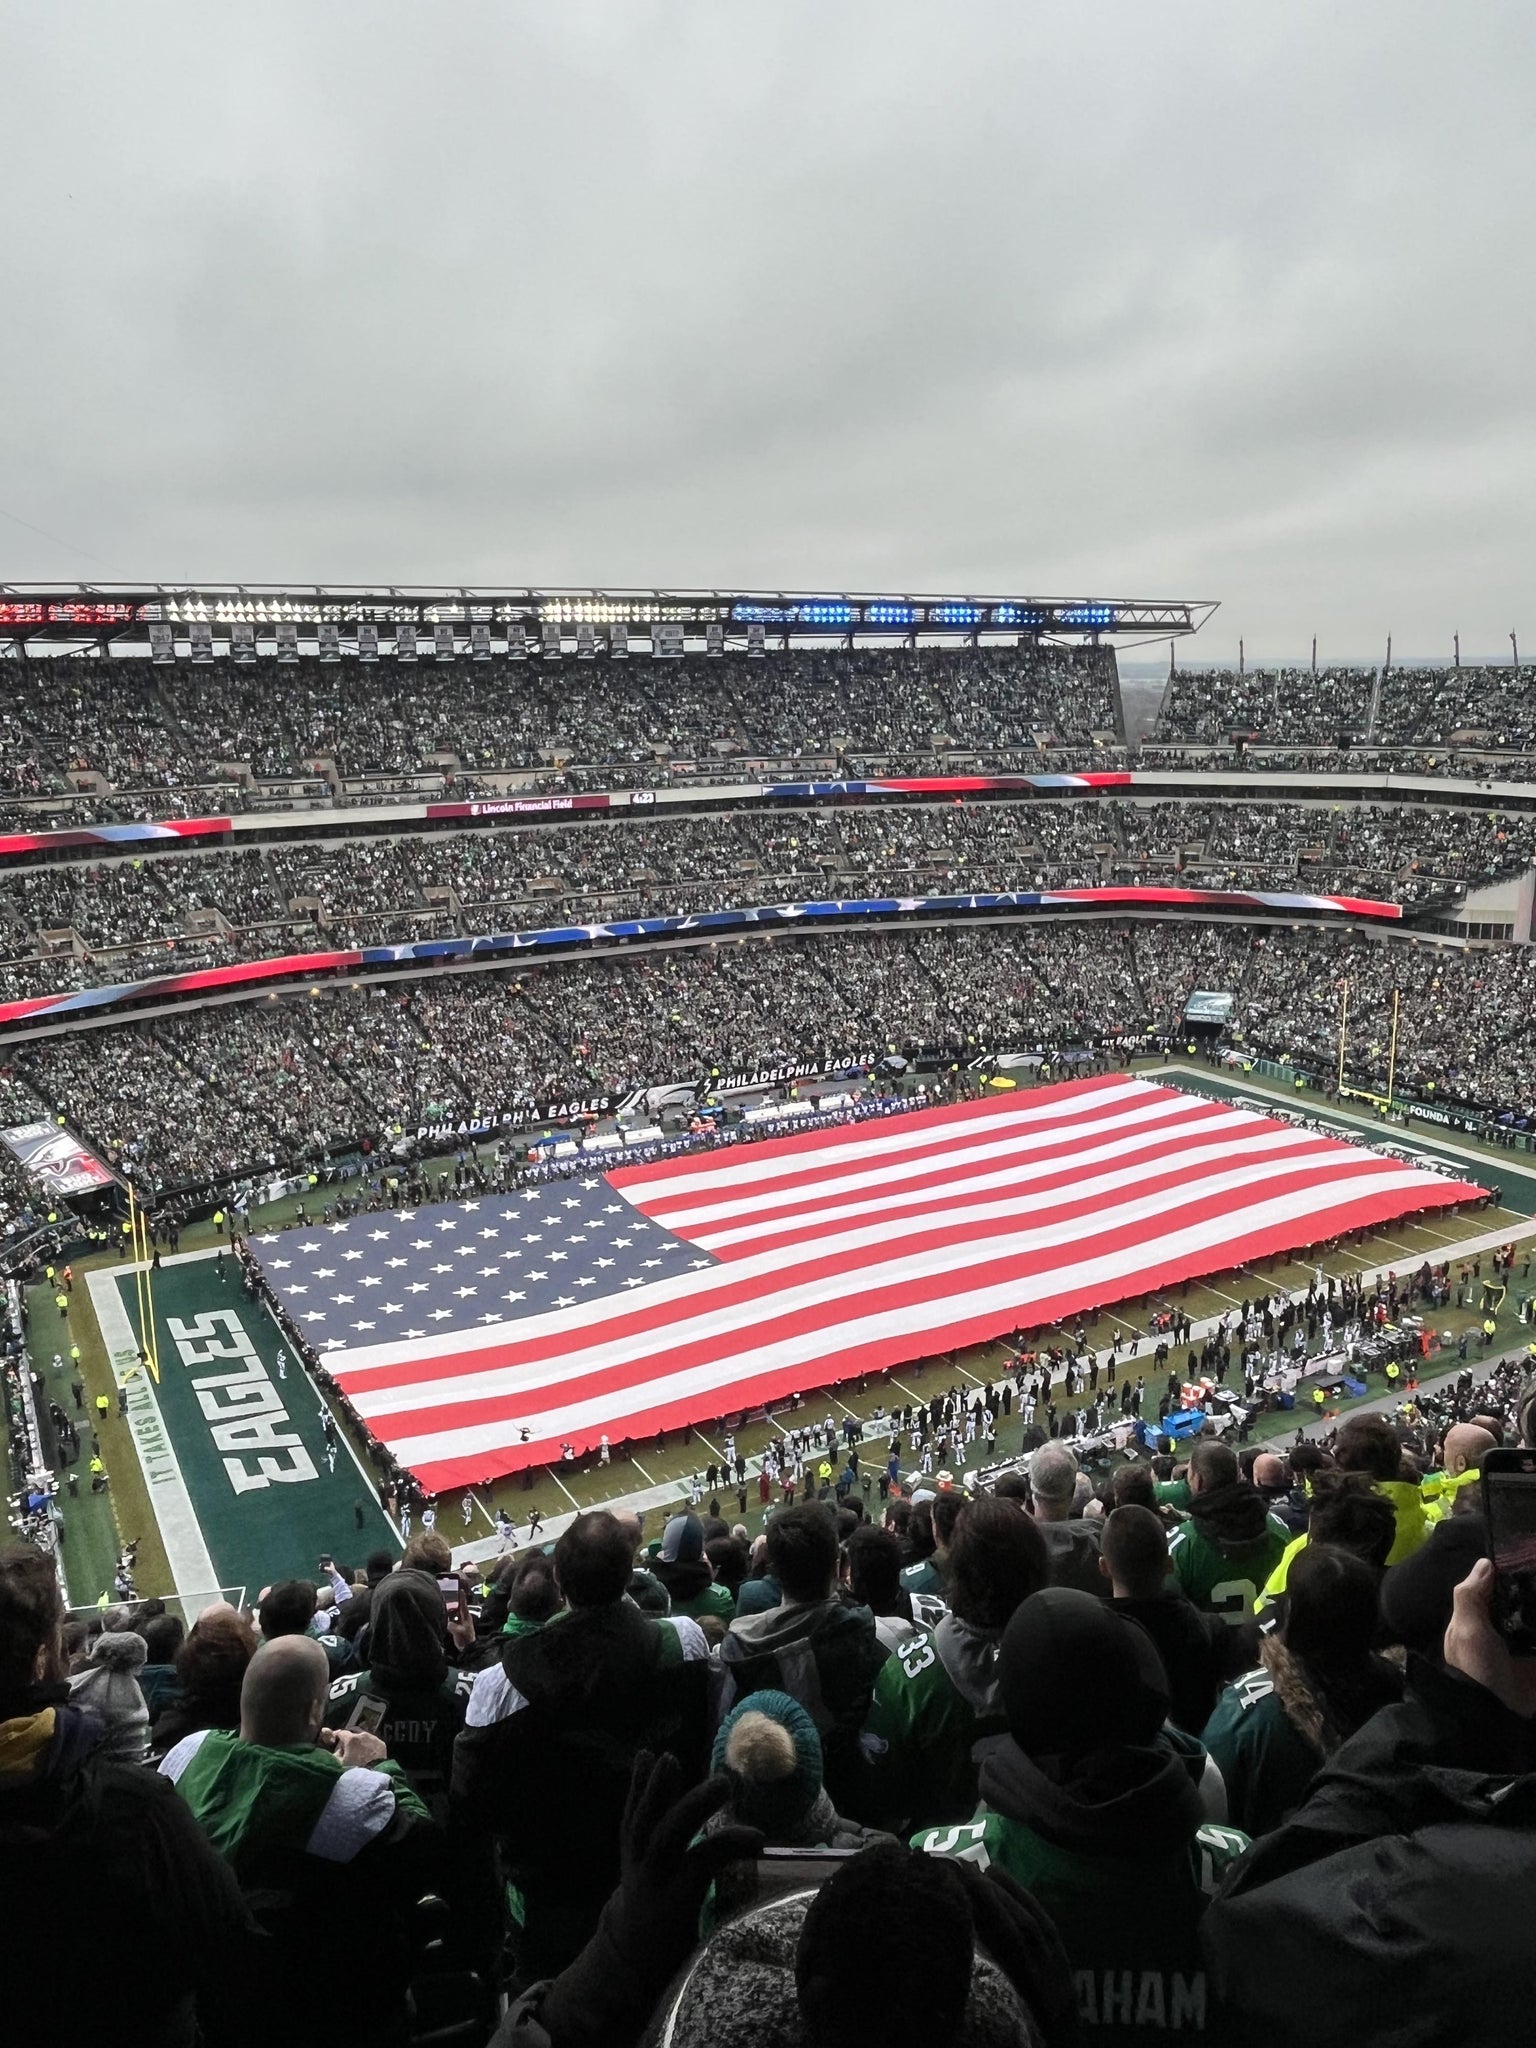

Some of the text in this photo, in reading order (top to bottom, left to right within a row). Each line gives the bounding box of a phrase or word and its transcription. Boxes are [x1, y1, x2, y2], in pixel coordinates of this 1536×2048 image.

[482, 798, 573, 814] Lincoln Financial Field
[716, 1052, 876, 1090] PHILADELPHIA EAGLES
[547, 1097, 610, 1118] EAGLES
[114, 1349, 139, 1366] US
[127, 1386, 154, 1412] ALL
[165, 1308, 320, 1496] EAGLES
[134, 1415, 170, 1464] TAKES
[150, 1468, 177, 1485] IT
[897, 1632, 936, 1679] 33
[1072, 1969, 1207, 2031] AHAM
